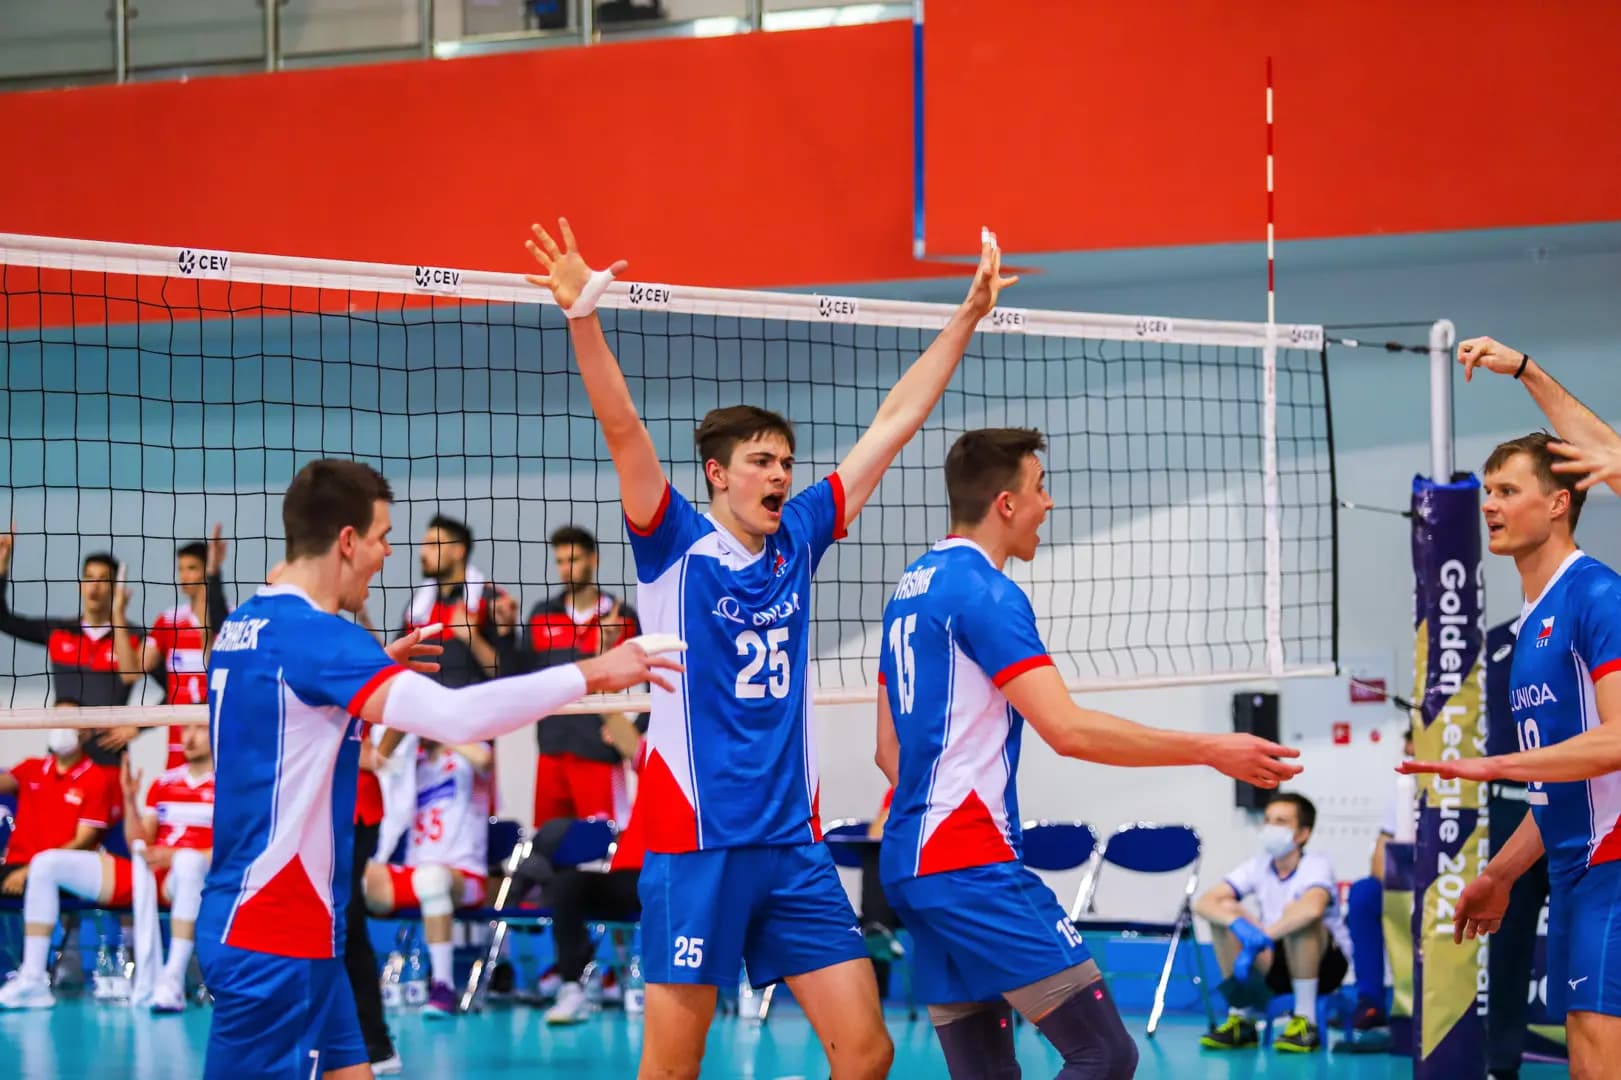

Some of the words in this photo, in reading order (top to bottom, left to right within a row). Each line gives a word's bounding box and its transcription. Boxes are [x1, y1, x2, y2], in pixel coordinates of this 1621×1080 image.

[199, 255, 228, 271] CEV
[433, 270, 459, 286] CEV
[645, 288, 670, 303] CEV
[834, 301, 856, 315] CEV
[1439, 559, 1468, 695] Golden
[735, 627, 790, 699] 25
[888, 613, 917, 715] 15
[1511, 682, 1558, 711] UNIQA
[211, 668, 230, 774] 7
[1433, 704, 1467, 844] League
[1056, 917, 1083, 948] 15
[673, 935, 705, 968] 25
